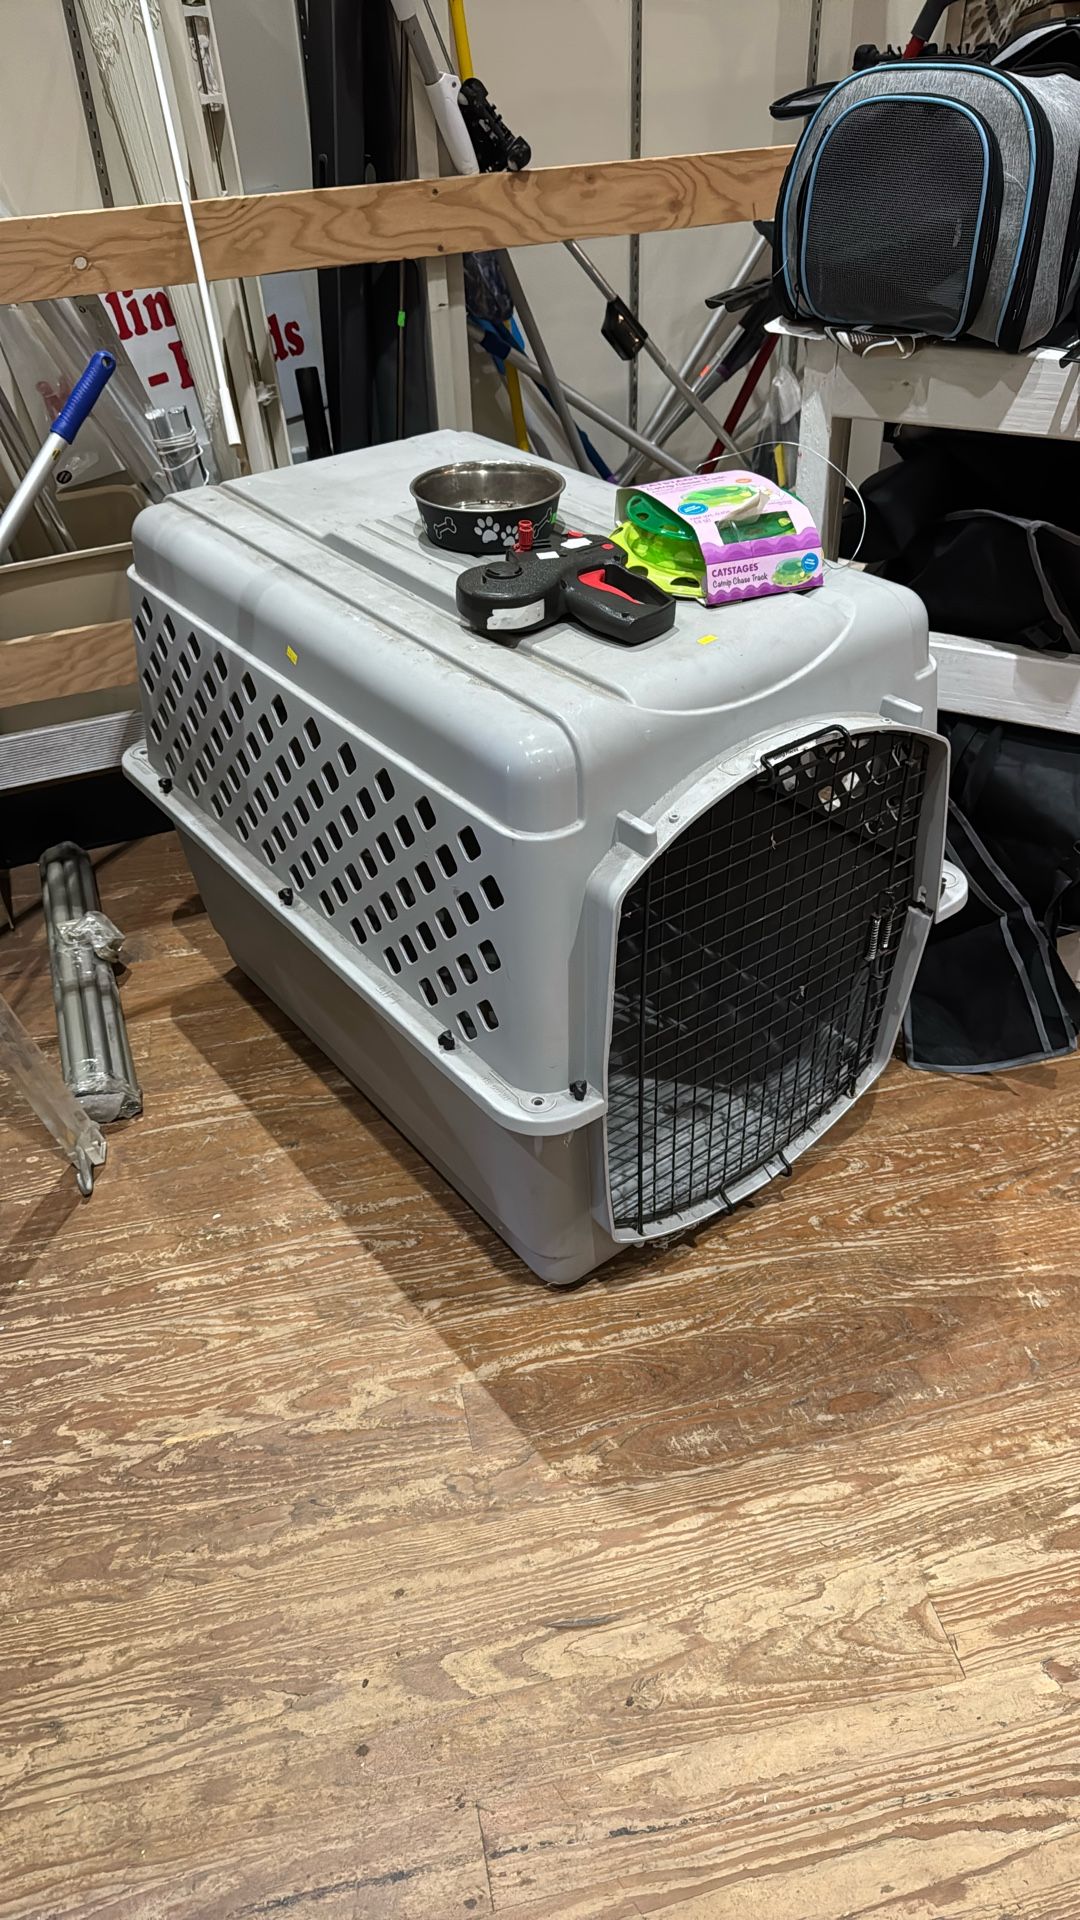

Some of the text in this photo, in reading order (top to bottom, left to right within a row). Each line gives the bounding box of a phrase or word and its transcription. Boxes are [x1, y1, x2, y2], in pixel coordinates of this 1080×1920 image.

[711, 562, 759, 578] CATSTAGES
[712, 572, 769, 589] Catnip Chase Track
